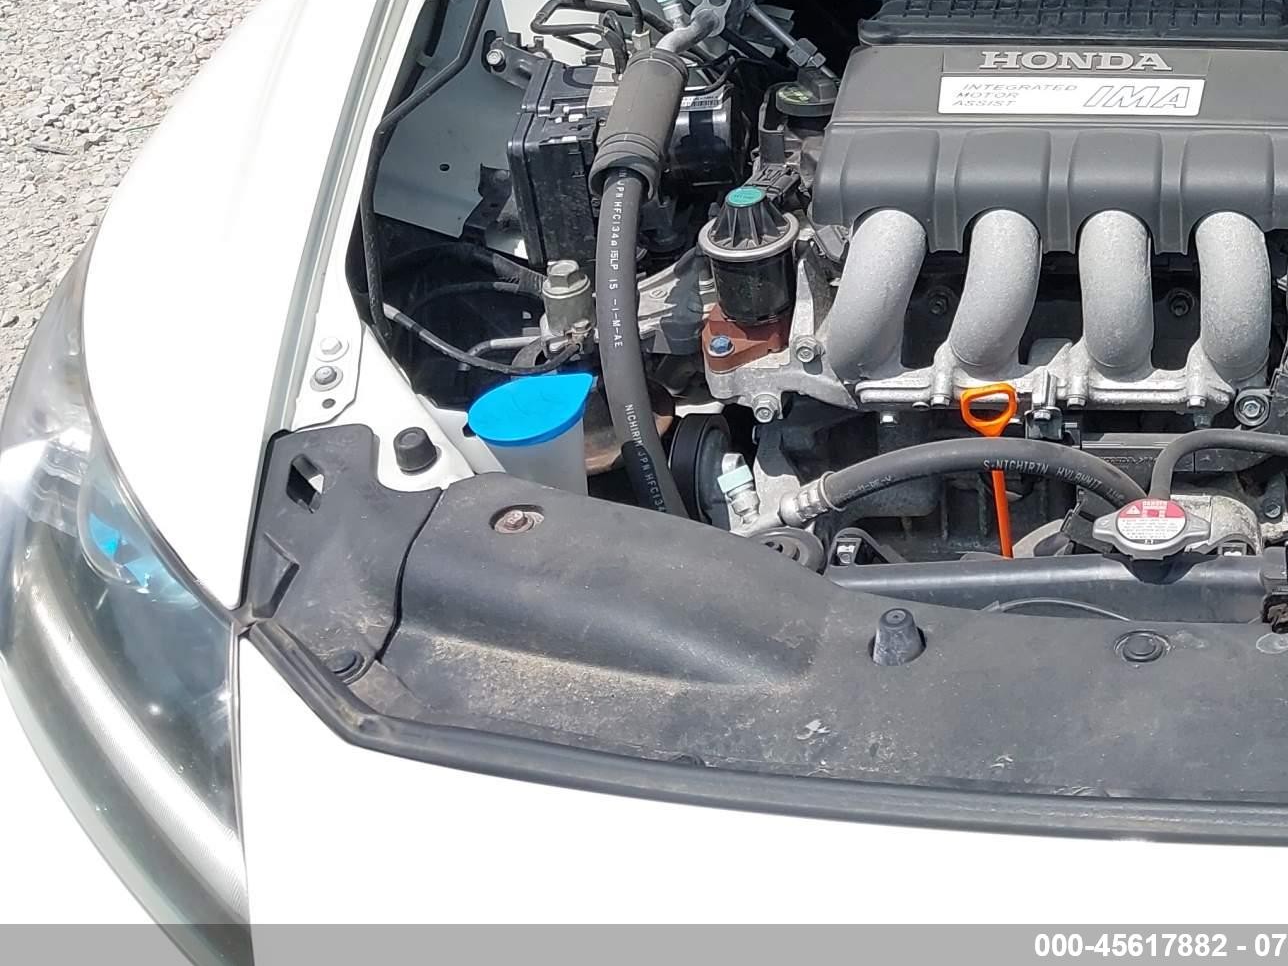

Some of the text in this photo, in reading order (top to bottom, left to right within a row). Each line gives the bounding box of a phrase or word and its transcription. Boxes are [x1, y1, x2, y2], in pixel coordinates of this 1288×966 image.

[980, 51, 1172, 72] HONDA
[956, 91, 1020, 100] MOTOR
[961, 83, 1190, 109] INTEGRATED IMA
[952, 99, 1017, 108] ASSIST
